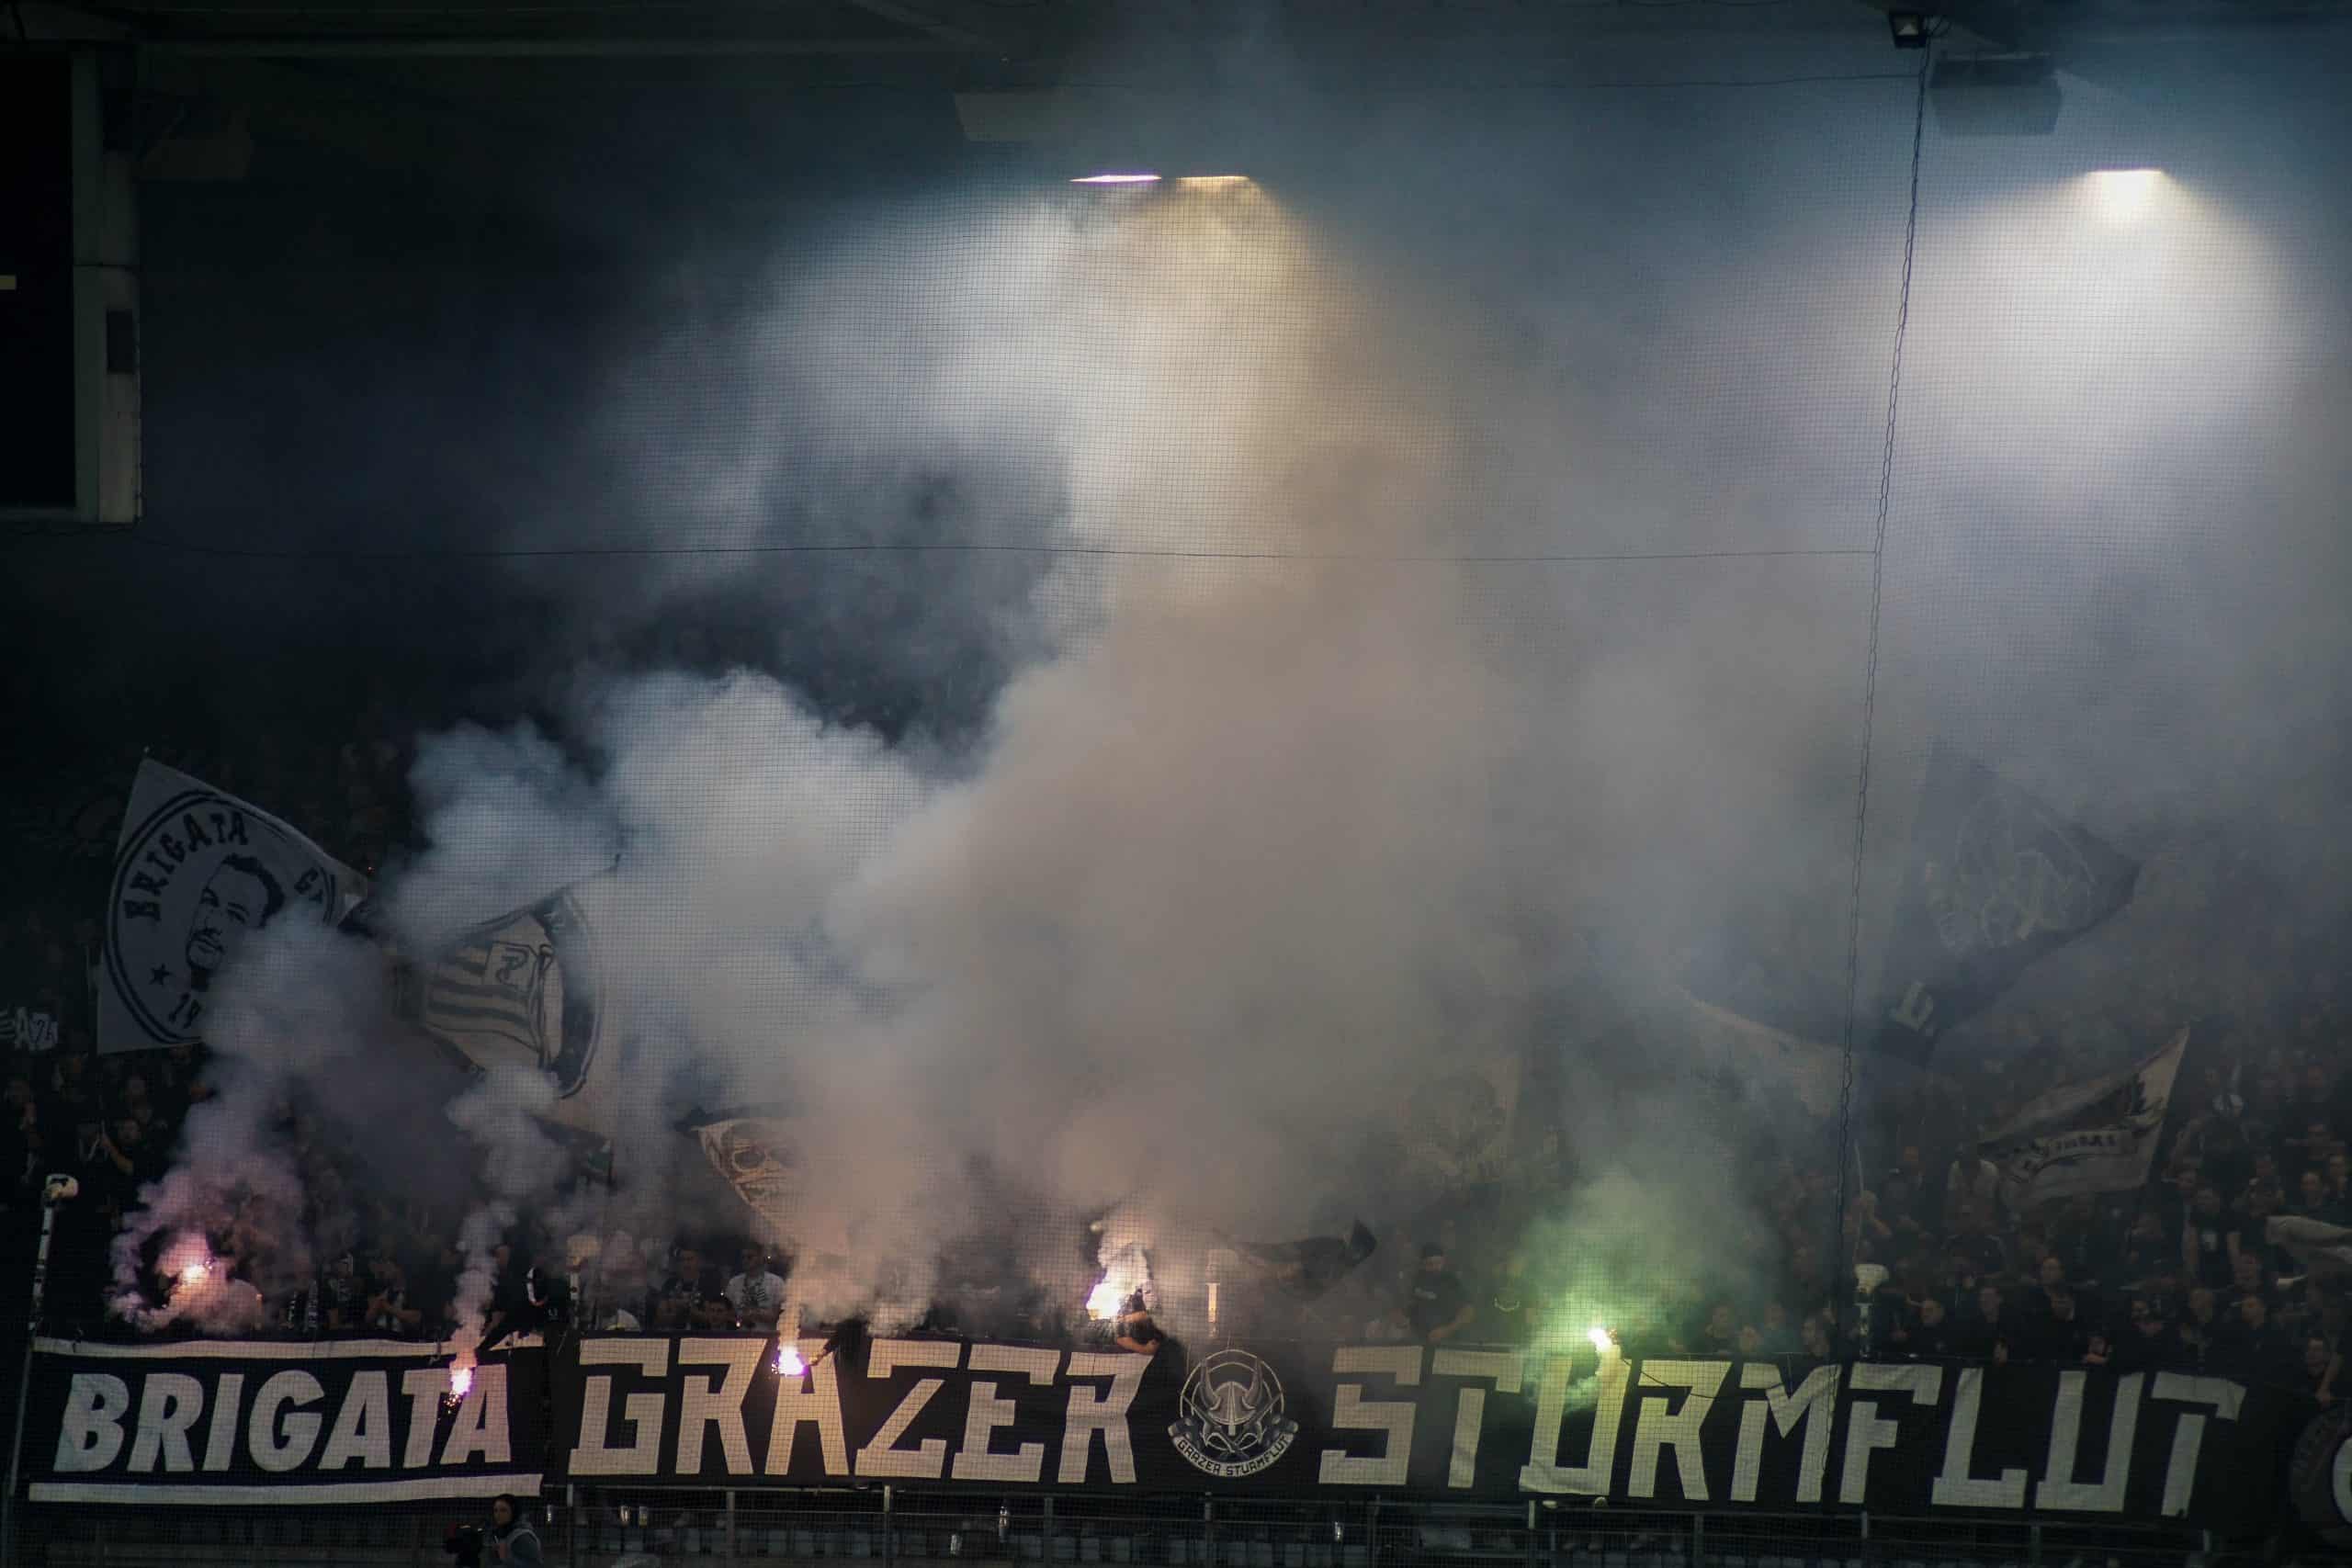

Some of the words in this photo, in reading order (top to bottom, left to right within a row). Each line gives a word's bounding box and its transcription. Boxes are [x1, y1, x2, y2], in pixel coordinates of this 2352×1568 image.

[123, 811, 250, 922] BRIGATA
[52, 1362, 512, 1473] BRIGATA
[567, 1337, 1155, 1484] GRAZER
[1318, 1345, 2247, 1517] STURMFLUT
[1178, 1439, 1221, 1475] GRAZER
[1226, 1435, 1290, 1476] STURMFLUT
